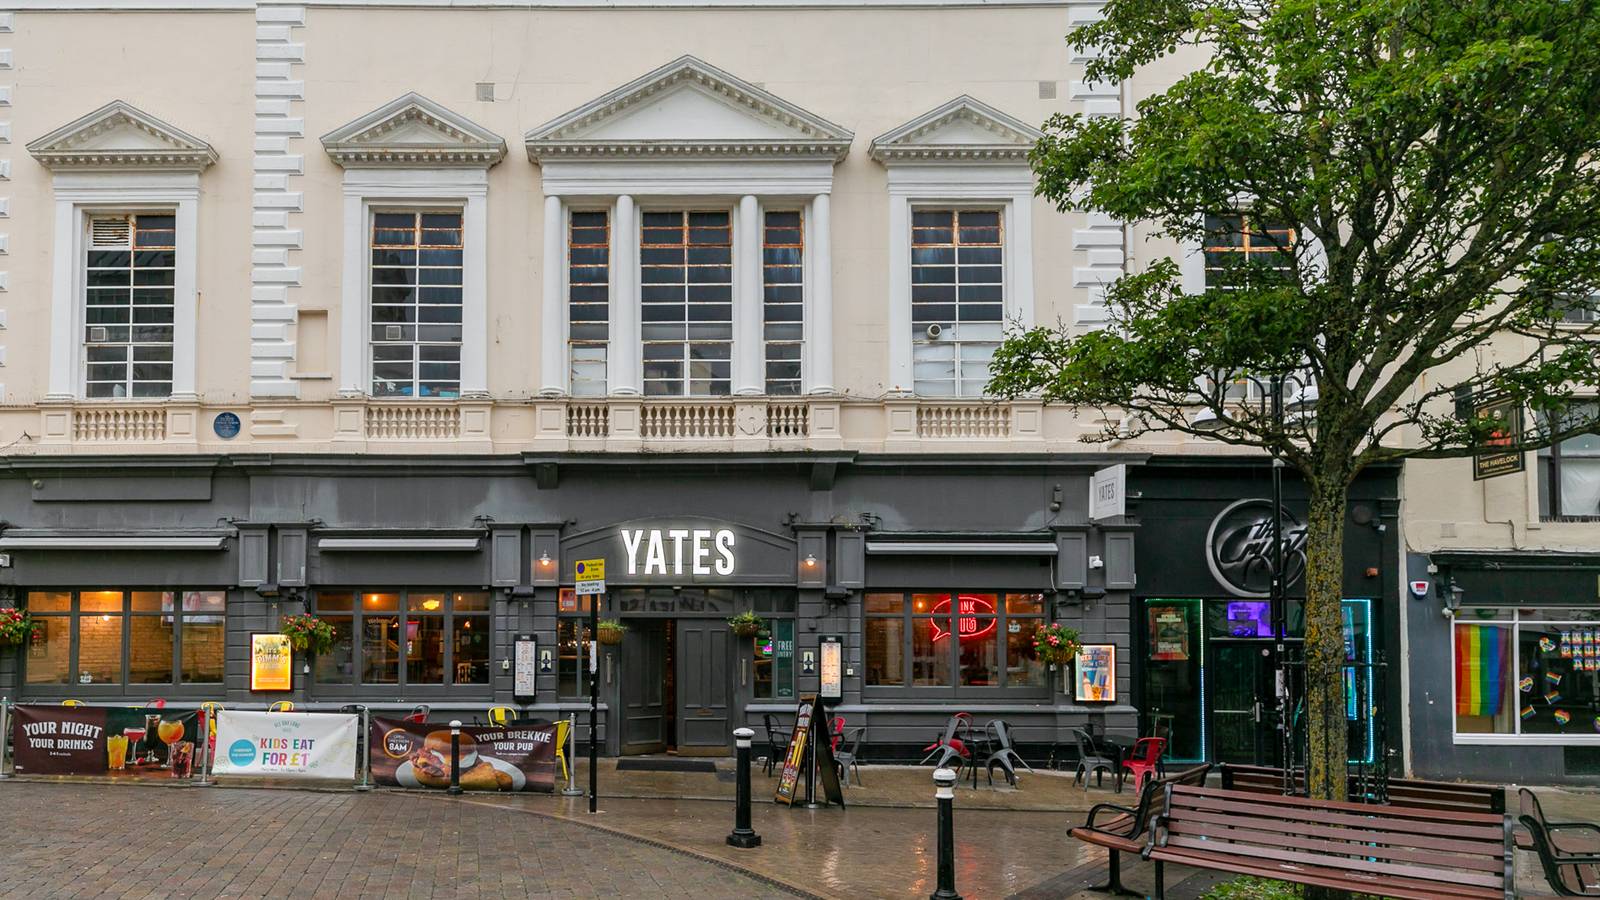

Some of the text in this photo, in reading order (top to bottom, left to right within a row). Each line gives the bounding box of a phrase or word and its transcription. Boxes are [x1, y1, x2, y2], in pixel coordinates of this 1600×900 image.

[1097, 482, 1115, 502] YATES
[620, 528, 735, 576] YATES
[777, 641, 793, 651] FREE
[22, 721, 102, 740] YOUR NIGHT
[476, 731, 552, 744] YOUR BREKKIE
[29, 738, 94, 751] YOUR DRINKS
[260, 738, 315, 751] KIDS EAT
[389, 743, 408, 752] 8AM
[493, 742, 534, 751] YOUR PUB
[262, 752, 288, 766] FOR
[290, 753, 310, 767] £1
